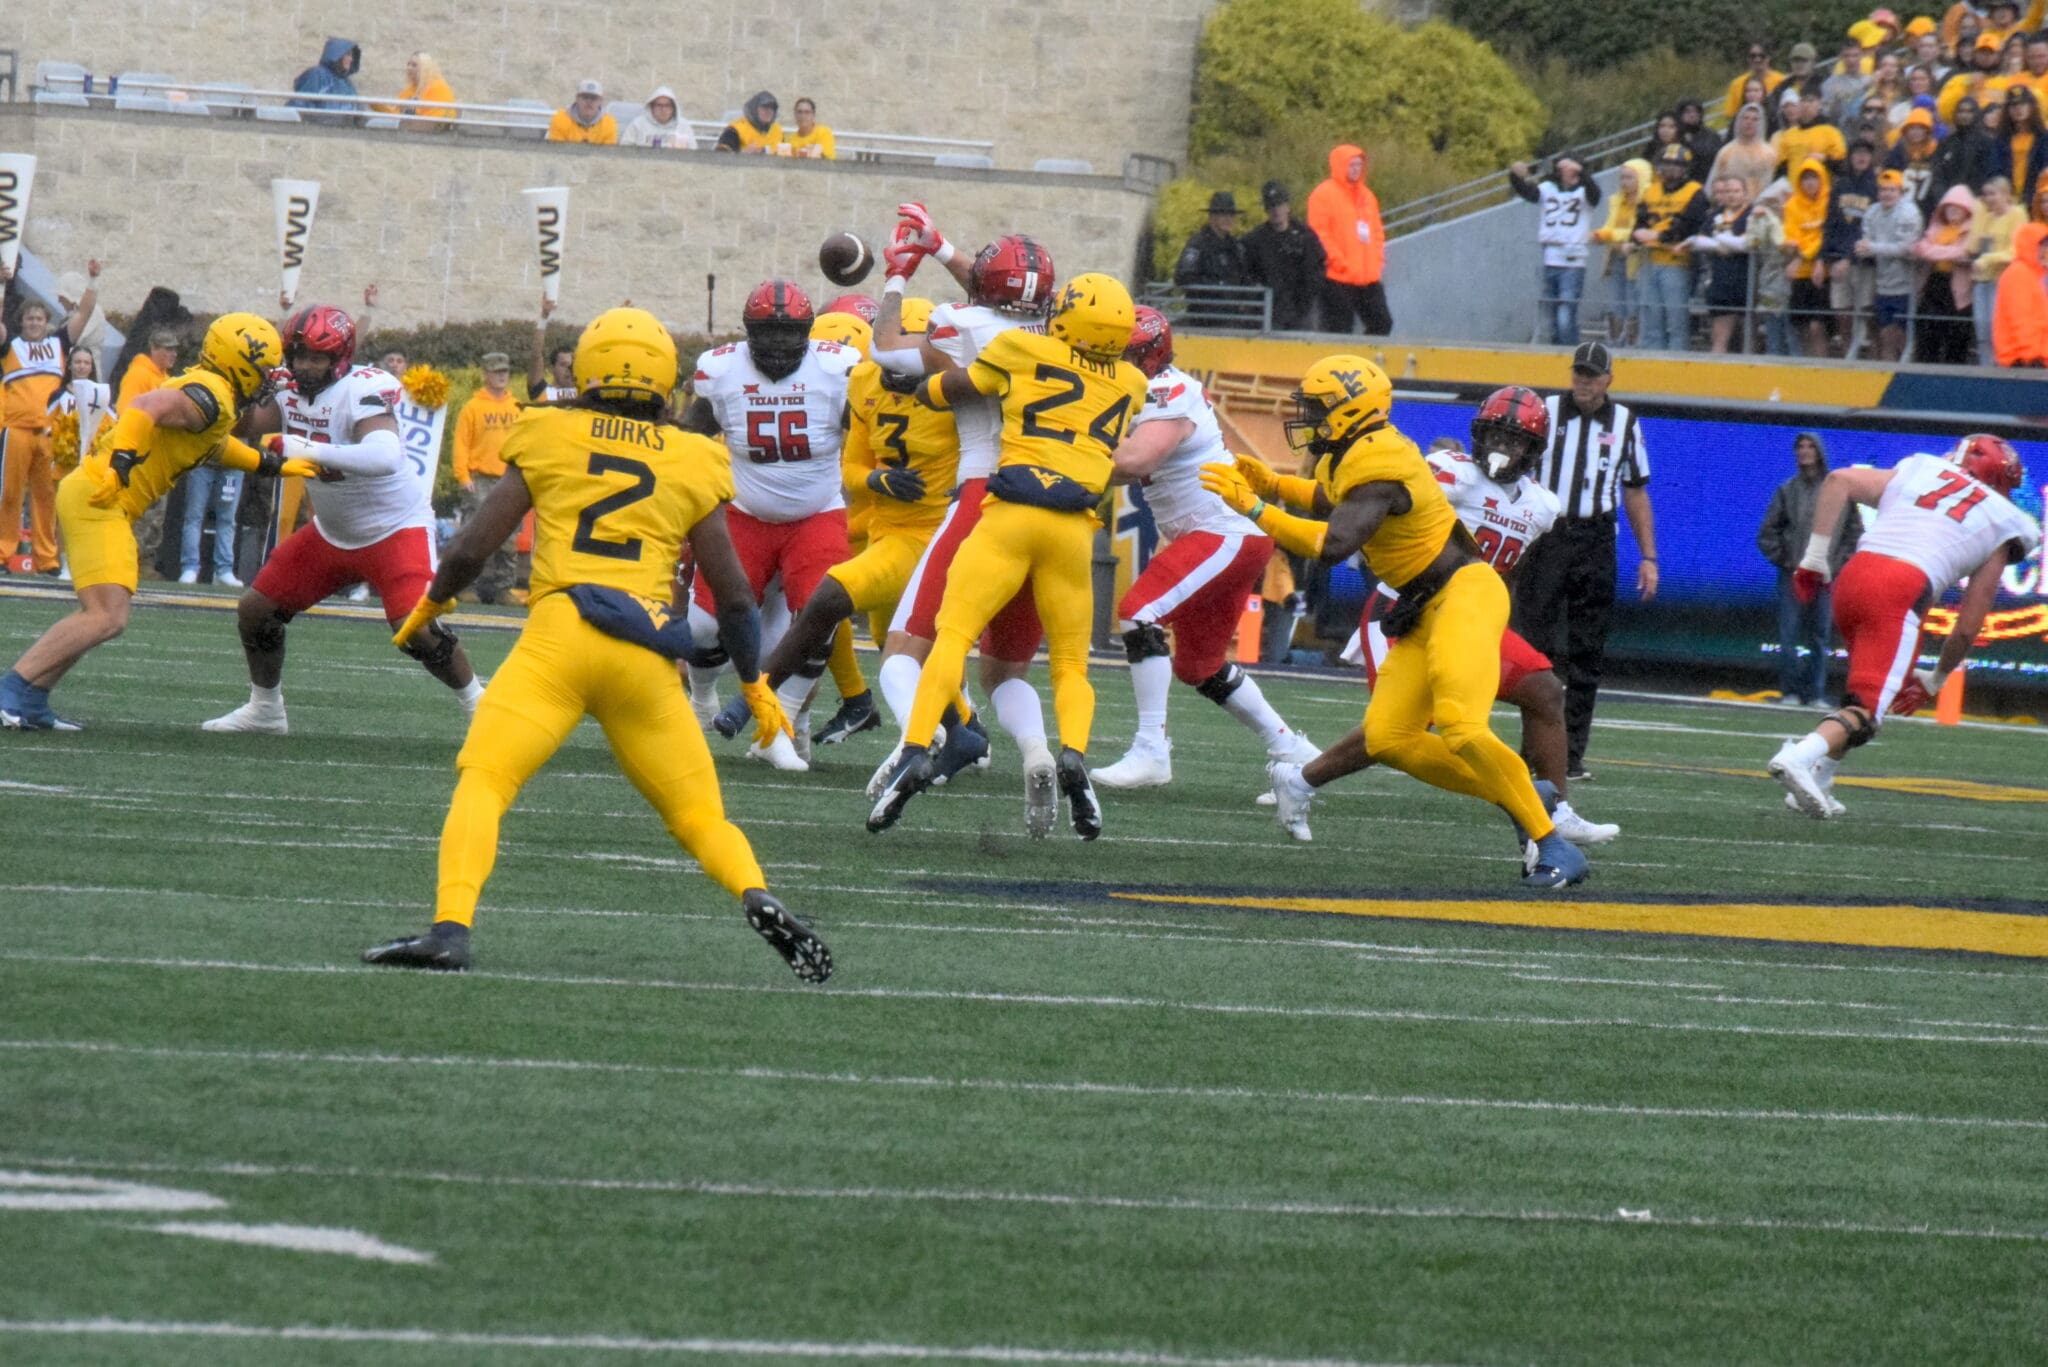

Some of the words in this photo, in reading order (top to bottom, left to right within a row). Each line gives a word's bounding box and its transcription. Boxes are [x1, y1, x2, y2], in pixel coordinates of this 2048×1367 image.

[283, 196, 310, 269] WVU
[1545, 197, 1581, 227] 23
[538, 206, 560, 276] WVU
[749, 396, 779, 406] TEXAS
[781, 396, 804, 405] TECH
[1022, 362, 1132, 451] 24
[591, 417, 665, 451] BURKS
[746, 410, 811, 463] 56
[877, 412, 910, 468] 3
[572, 452, 656, 562] 2
[1914, 469, 1989, 524] 71
